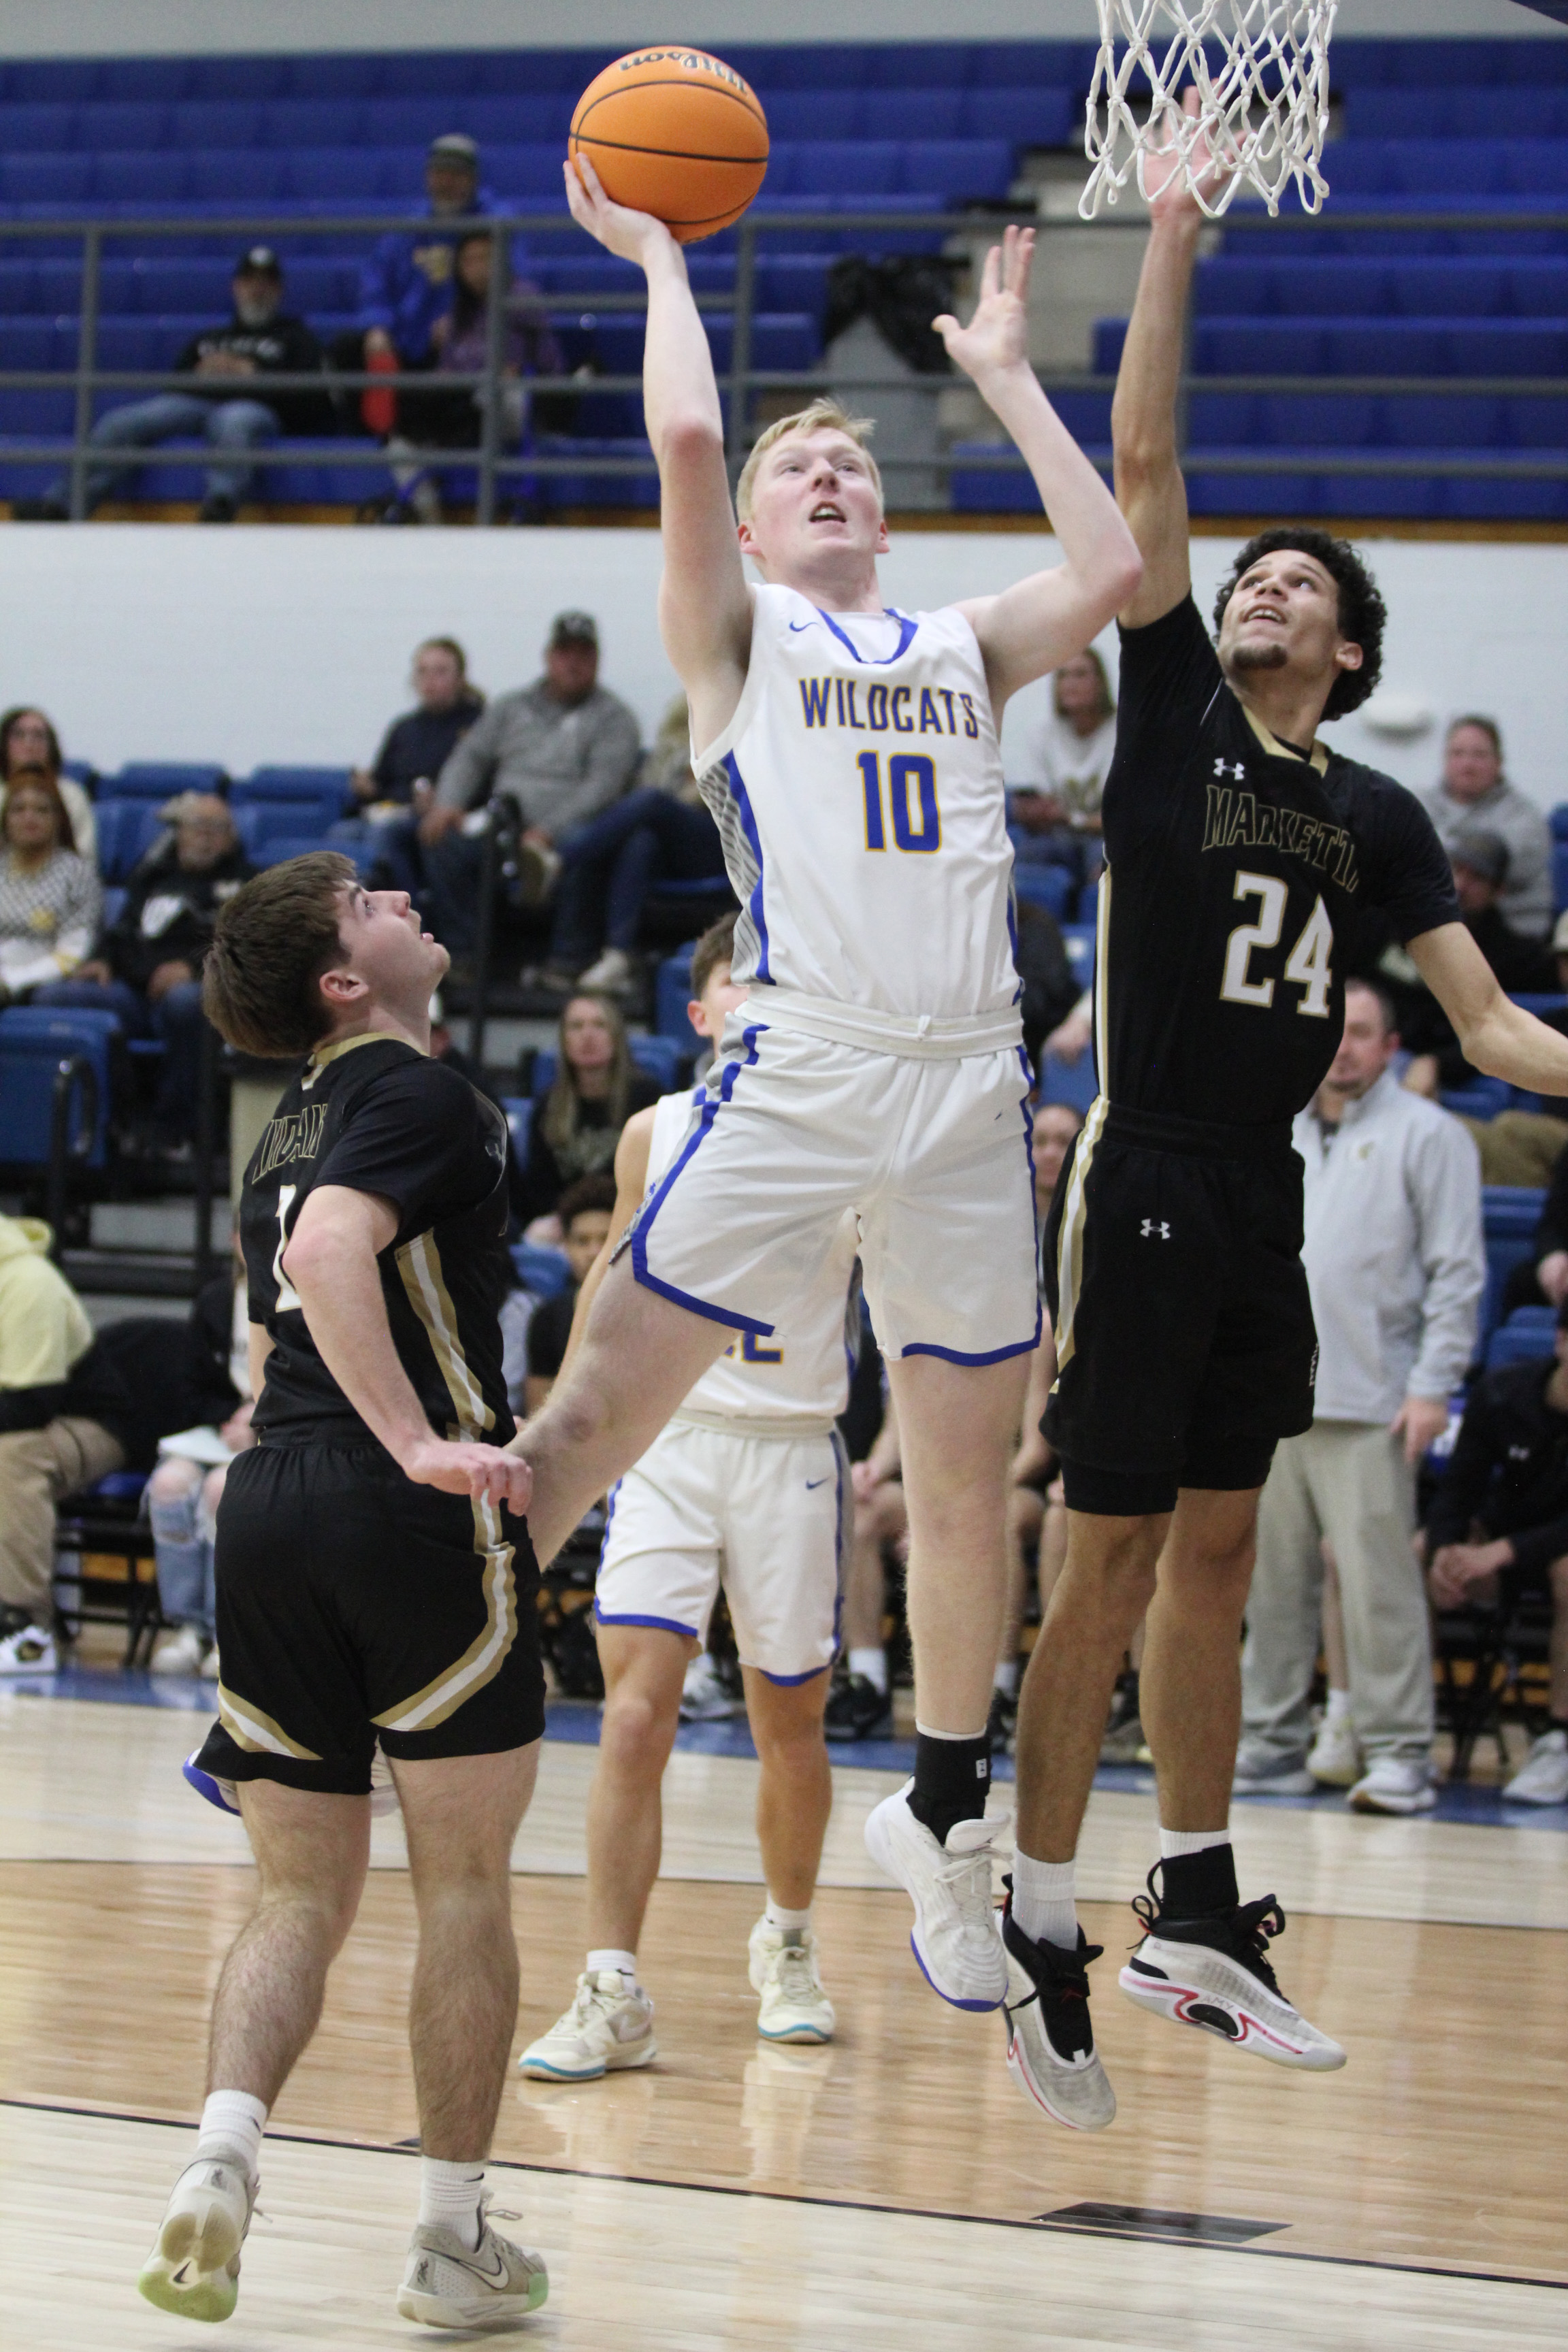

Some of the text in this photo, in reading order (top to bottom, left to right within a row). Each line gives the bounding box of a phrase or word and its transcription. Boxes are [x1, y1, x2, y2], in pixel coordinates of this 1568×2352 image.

[798, 676, 979, 740] WILDCATS
[855, 749, 943, 855] 10
[1219, 870, 1334, 1019] 24
